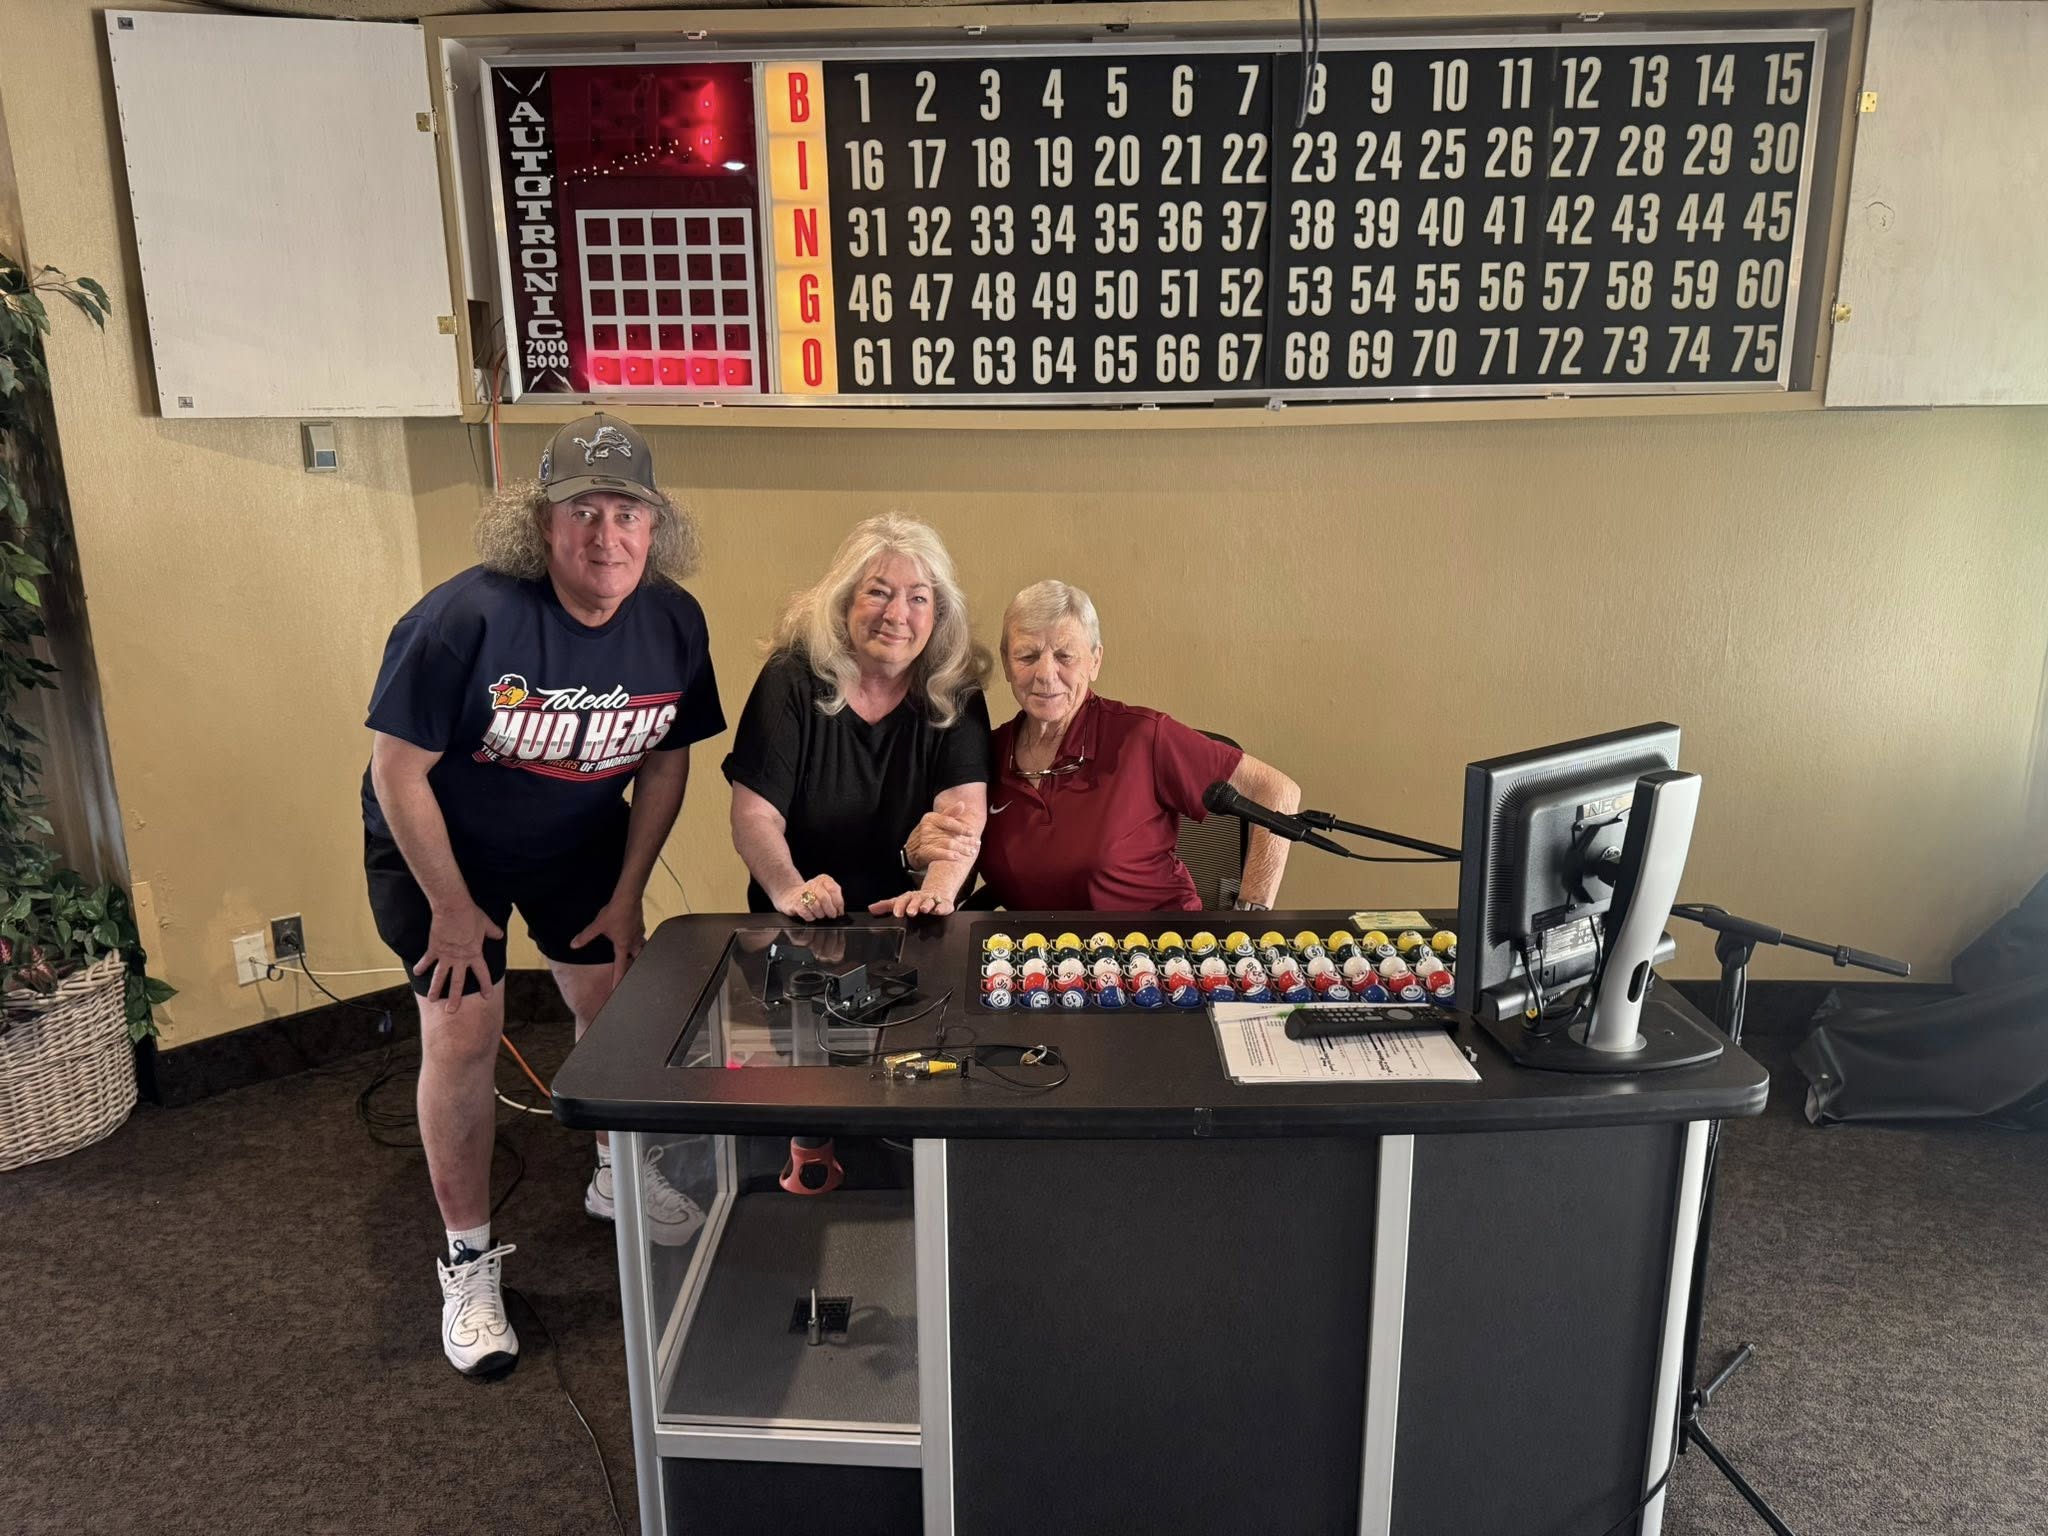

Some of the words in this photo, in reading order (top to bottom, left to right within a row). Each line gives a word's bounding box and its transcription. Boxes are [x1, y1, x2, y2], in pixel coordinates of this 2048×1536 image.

[855, 73, 870, 122] 1
[916, 71, 936, 121] 2
[981, 69, 1000, 120] 3
[1043, 69, 1064, 118] 4
[1108, 67, 1127, 118] 5
[1173, 65, 1193, 116] 6
[1238, 65, 1258, 115] 7
[1306, 63, 1327, 115] 8
[1372, 62, 1392, 113] 9
[1430, 59, 1468, 111] 10
[1499, 58, 1532, 109] 11
[1562, 57, 1601, 108] 12
[1630, 55, 1668, 107] 13
[1696, 55, 1734, 105] 14
[1765, 53, 1804, 104] 15
[845, 140, 884, 190] 16
[909, 139, 946, 188] 17
[972, 137, 1010, 188] 18
[1035, 136, 1072, 187] 19
[1095, 135, 1139, 186] 20
[1161, 135, 1201, 184] 21
[1222, 133, 1267, 183] 22
[1292, 132, 1337, 182] 23
[1356, 131, 1402, 181] 24
[1419, 129, 1466, 179] 25
[1485, 126, 1532, 177] 26
[1550, 127, 1600, 177] 27
[1617, 125, 1665, 176] 28
[1683, 123, 1732, 175] 29
[1751, 122, 1799, 174] 30
[508, 101, 563, 339] AUTOTRONIC
[849, 207, 886, 257] 31
[908, 206, 951, 256] 32
[971, 205, 1013, 255] 33
[1032, 205, 1076, 255] 34
[1095, 203, 1138, 253] 35
[1159, 201, 1202, 252] 36
[1222, 201, 1266, 251] 37
[1290, 199, 1335, 250] 38
[1354, 198, 1399, 249] 39
[1418, 196, 1464, 246] 40
[1484, 196, 1525, 244] 41
[1546, 195, 1594, 244] 42
[1612, 193, 1660, 243] 43
[1677, 193, 1725, 242] 44
[1743, 192, 1792, 241] 45
[849, 273, 892, 322] 46
[910, 274, 953, 321] 47
[972, 272, 1015, 321] 48
[1032, 271, 1076, 320] 49
[1095, 270, 1138, 319] 50
[1161, 270, 1198, 318] 51
[1220, 268, 1263, 317] 52
[1288, 266, 1332, 316] 53
[1351, 266, 1396, 314] 54
[1415, 264, 1460, 312] 55
[1479, 262, 1525, 311] 56
[1543, 262, 1589, 310] 57
[1607, 261, 1653, 310] 58
[1672, 260, 1719, 309] 59
[1737, 259, 1784, 308] 60
[525, 340, 569, 354] 7000
[527, 355, 570, 369] 5000
[854, 338, 891, 386] 61
[913, 337, 955, 385] 62
[973, 336, 1015, 385] 63
[1033, 336, 1076, 384] 64
[1095, 335, 1137, 383] 65
[1157, 334, 1199, 382] 66
[1219, 333, 1262, 381] 67
[1285, 331, 1329, 380] 68
[1348, 330, 1393, 379] 69
[1413, 328, 1456, 376] 70
[1480, 328, 1518, 374] 71
[1538, 327, 1583, 374] 72
[1603, 326, 1648, 374] 73
[1667, 326, 1710, 373] 74
[1731, 325, 1777, 372] 75
[536, 684, 630, 711] Toledo
[481, 745, 500, 762] THE
[580, 761, 597, 772] OF
[482, 710, 581, 760] MUD
[578, 704, 677, 760] HENS
